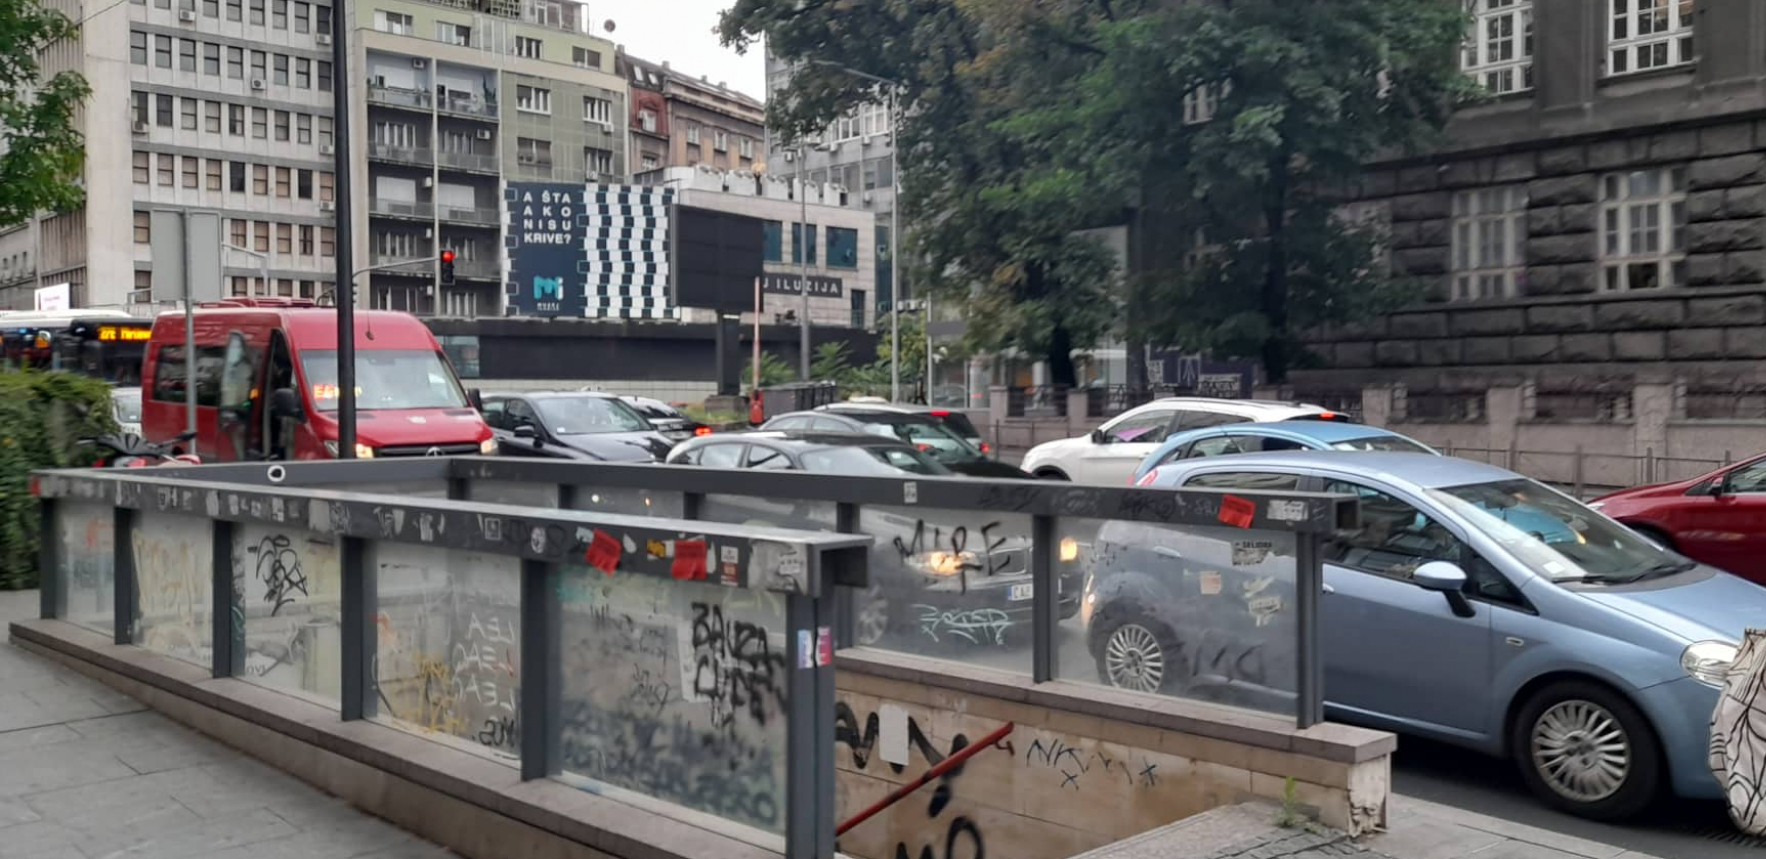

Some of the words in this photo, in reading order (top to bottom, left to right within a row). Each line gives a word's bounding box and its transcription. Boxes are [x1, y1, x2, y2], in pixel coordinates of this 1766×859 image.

[541, 190, 571, 204] ŠTA
[523, 219, 572, 231] NISU
[523, 232, 572, 244] KRIVE?
[776, 277, 838, 294] ILUZIJA
